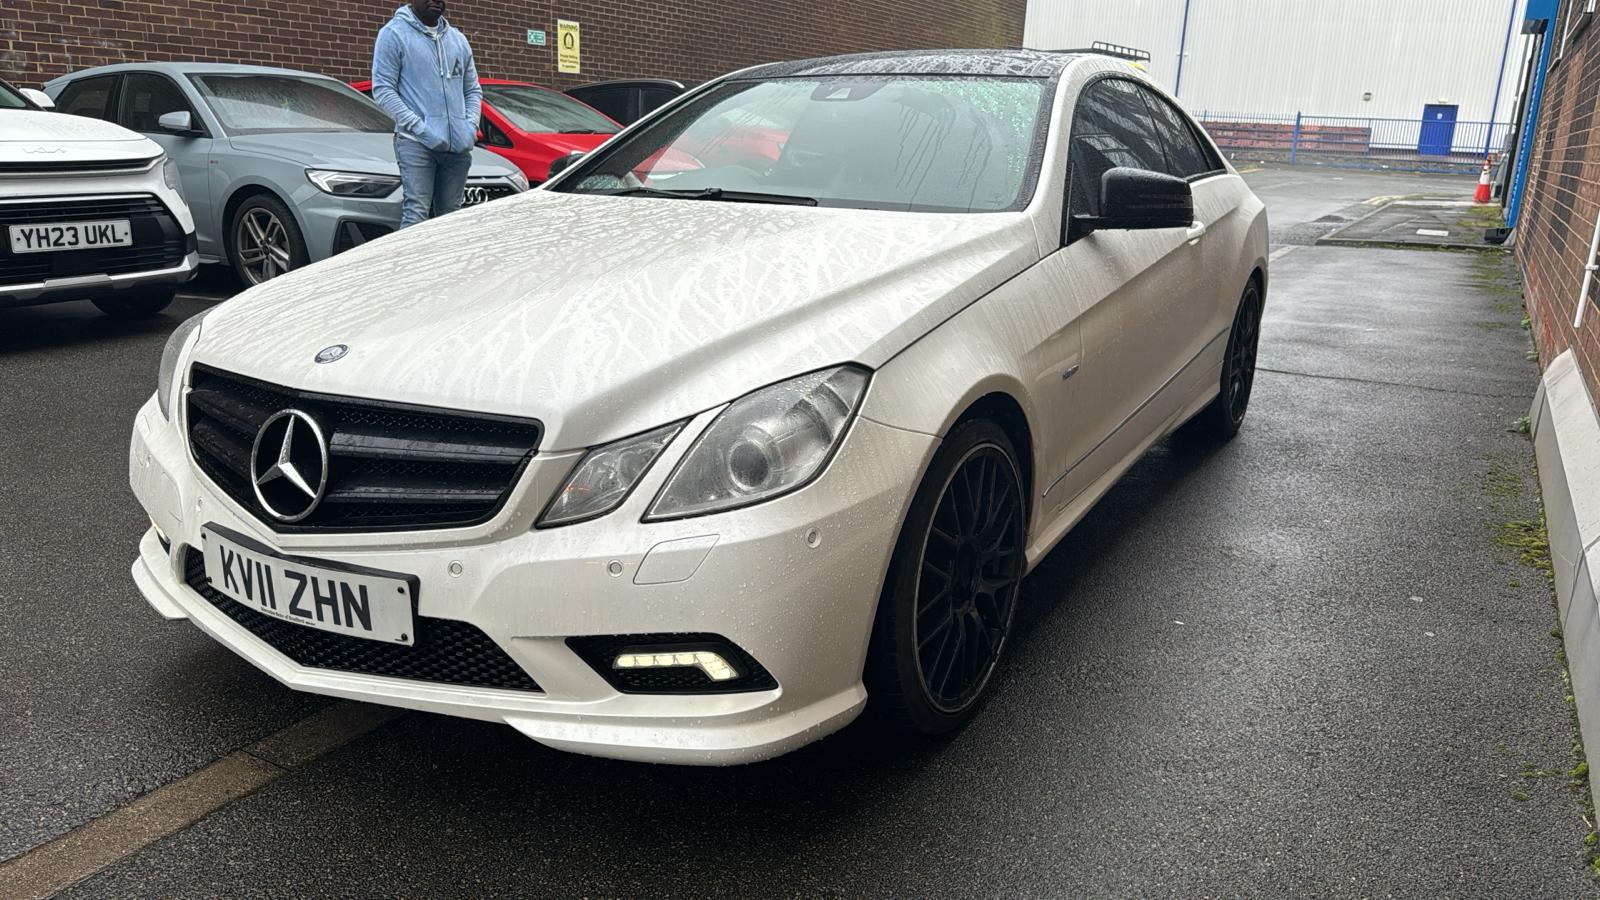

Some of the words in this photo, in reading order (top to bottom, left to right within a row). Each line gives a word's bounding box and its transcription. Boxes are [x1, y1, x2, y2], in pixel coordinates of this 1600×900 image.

[20, 226, 79, 248] YH23
[84, 224, 124, 245] UKL
[219, 544, 277, 611] KV11
[284, 569, 373, 632] ZHN
